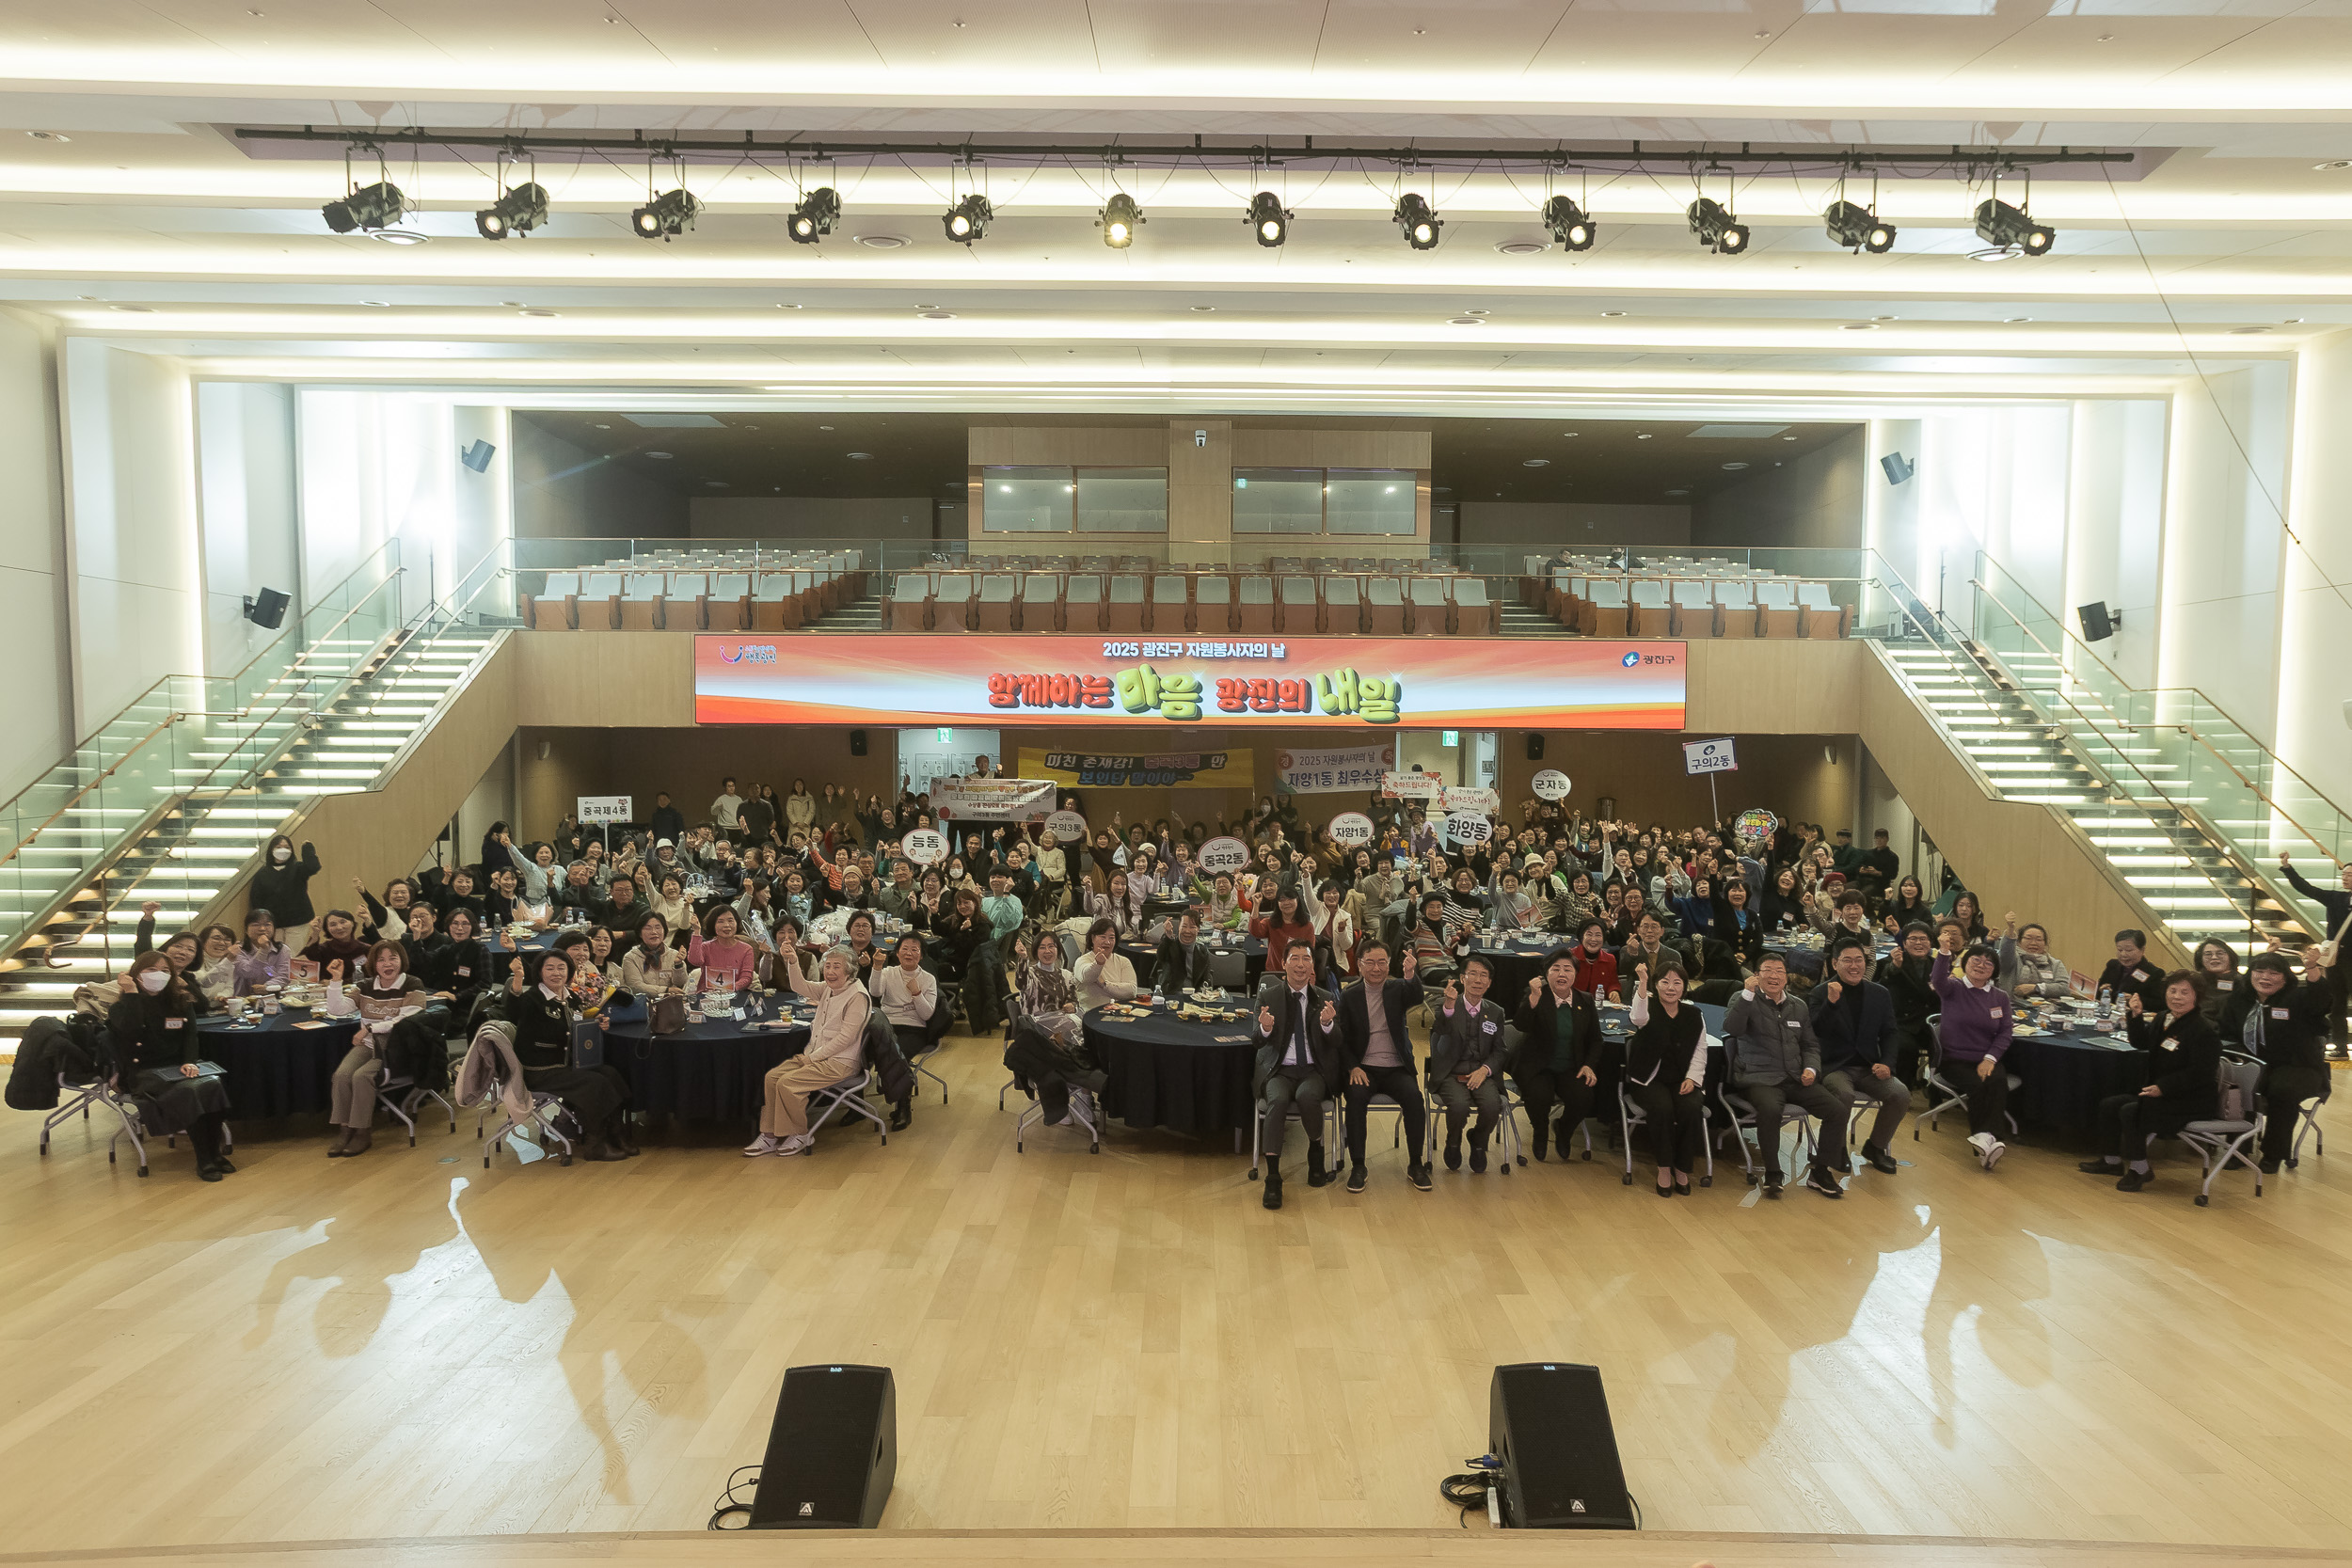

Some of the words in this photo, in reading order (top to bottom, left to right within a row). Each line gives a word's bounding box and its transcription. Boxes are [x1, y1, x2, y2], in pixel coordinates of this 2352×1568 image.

[1103, 642, 1139, 657] 2025
[1142, 642, 1184, 657] 광진구
[1186, 643, 1268, 657] 자원봉사자의
[1271, 643, 1286, 658] 날
[1643, 655, 1676, 665] 광진구
[988, 673, 1112, 707] 함께하는
[1116, 663, 1200, 719] 마음
[1216, 678, 1309, 712] 광진의
[1316, 667, 1399, 722] 내일
[1046, 753, 1076, 768] 미친
[1083, 754, 1134, 768] 존재감!
[1211, 754, 1226, 768] 만
[1280, 755, 1290, 768] 경
[1299, 755, 1321, 766] 2025
[1323, 752, 1366, 766] 자원봉사자의
[1368, 752, 1375, 763] 날
[1692, 755, 1731, 770] 구의2동
[1080, 771, 1126, 785] 보인단
[1288, 771, 1333, 787] 자양1동
[1337, 768, 1385, 785] 최우수상
[1535, 780, 1566, 789] 군자동
[1392, 781, 1432, 789] 축하드립니다!
[1450, 794, 1491, 805] 축하드립니다!
[583, 805, 628, 816] 중곡제4동
[1049, 822, 1081, 833] 구의3동
[1335, 827, 1369, 838] 자양1동
[1446, 818, 1487, 841] 화양동
[1204, 851, 1244, 867] 중곡2동
[299, 965, 308, 978] 5
[716, 972, 724, 986] 4
